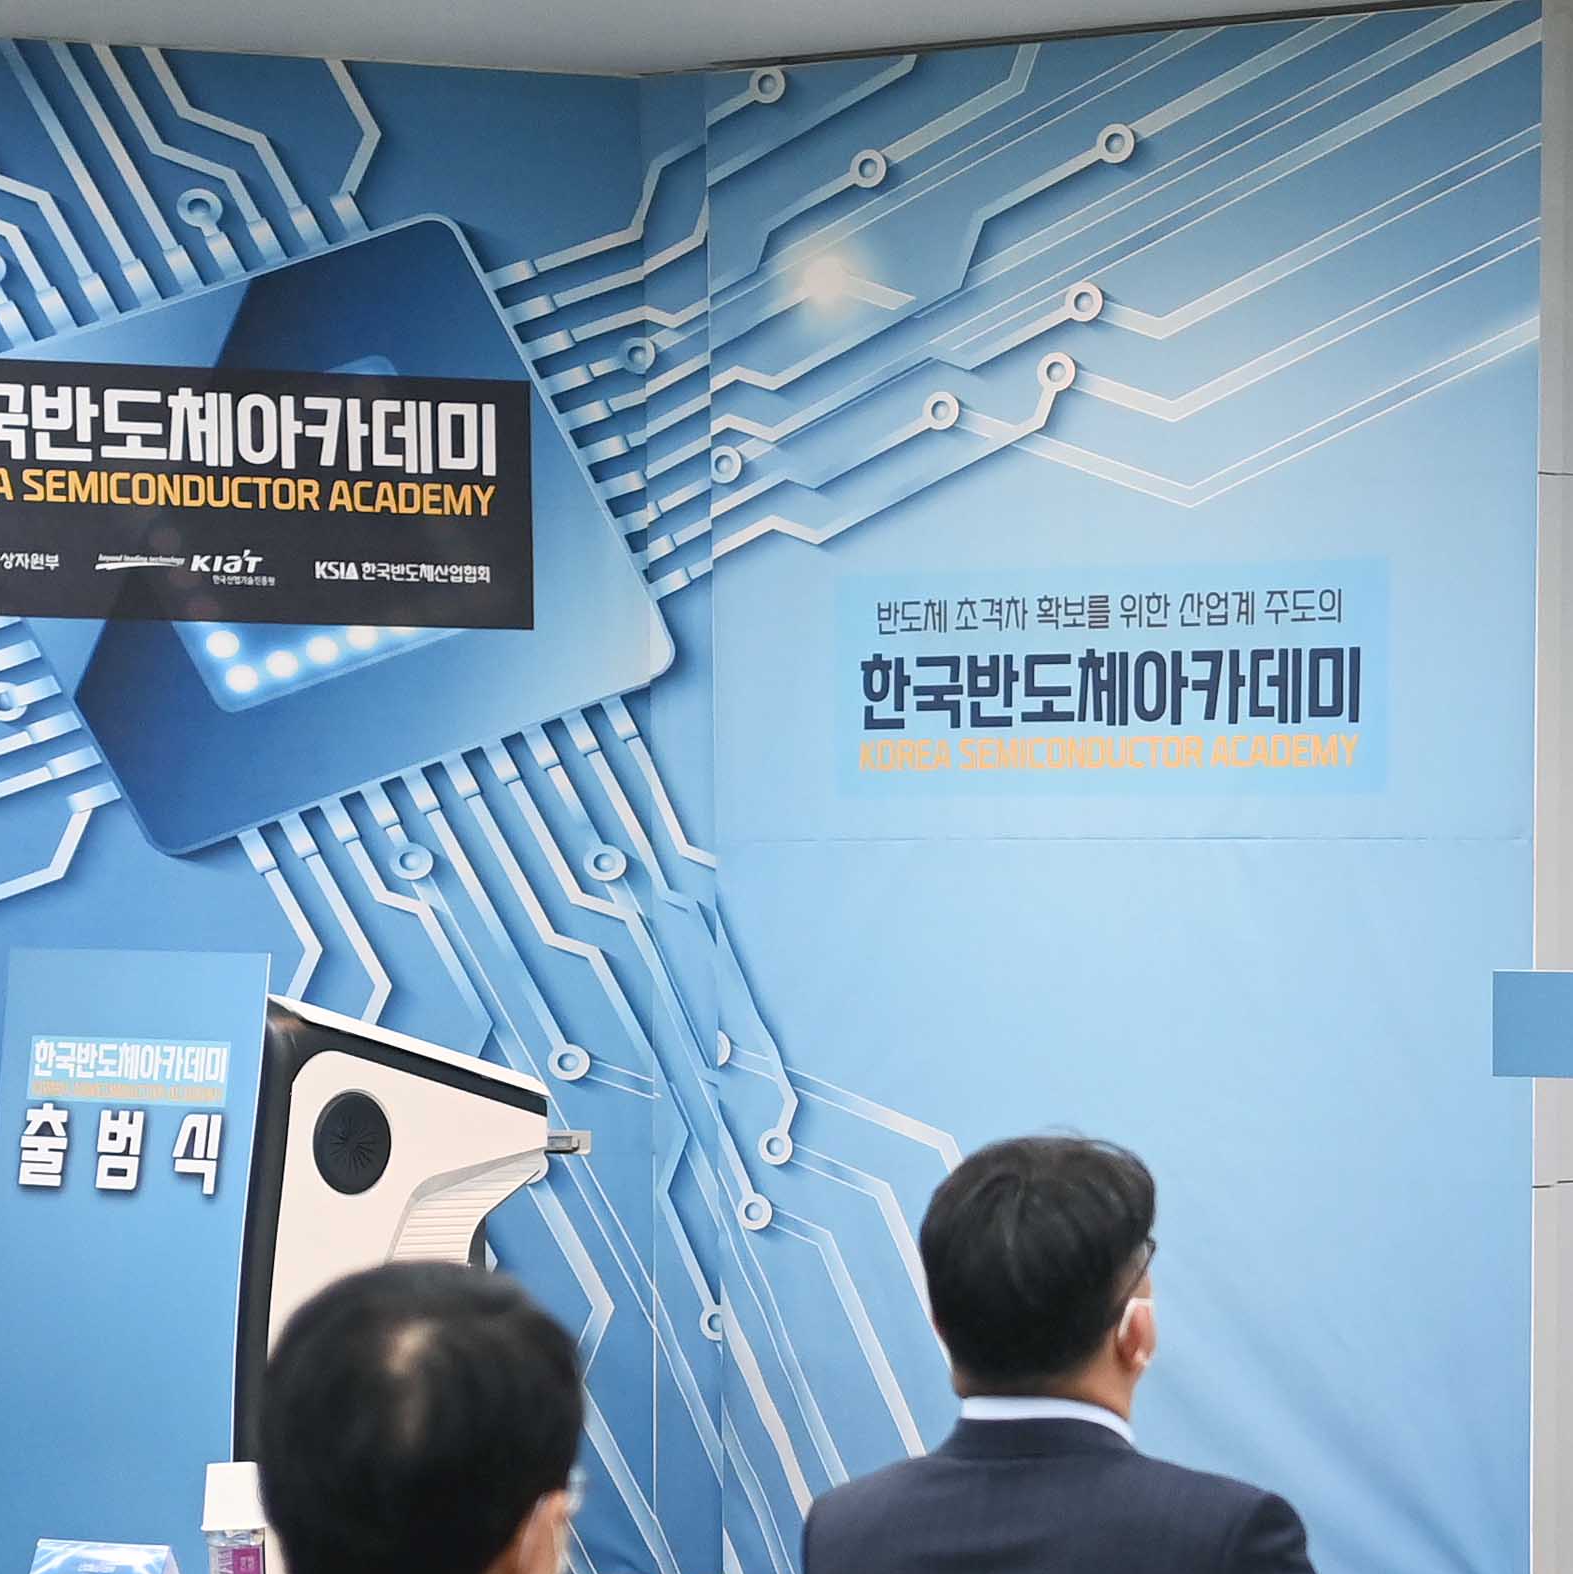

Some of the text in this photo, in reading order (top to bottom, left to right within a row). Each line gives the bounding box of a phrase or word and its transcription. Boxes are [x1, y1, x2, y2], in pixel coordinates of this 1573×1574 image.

[23, 468, 321, 511] SEMICONDUCTOR
[328, 479, 496, 516] ACADEMY
[315, 561, 359, 580] KSIA
[361, 562, 491, 583] 한국반도체산업협회
[877, 588, 1342, 635] 반도체 초격차 확보를 위한 산업계 주도의
[860, 646, 1361, 730] 한국반도체아카데미
[859, 734, 1360, 771] KOREA SEMICONDUCTOR ACADEMY
[34, 1040, 227, 1083] 한국반도체아카데미
